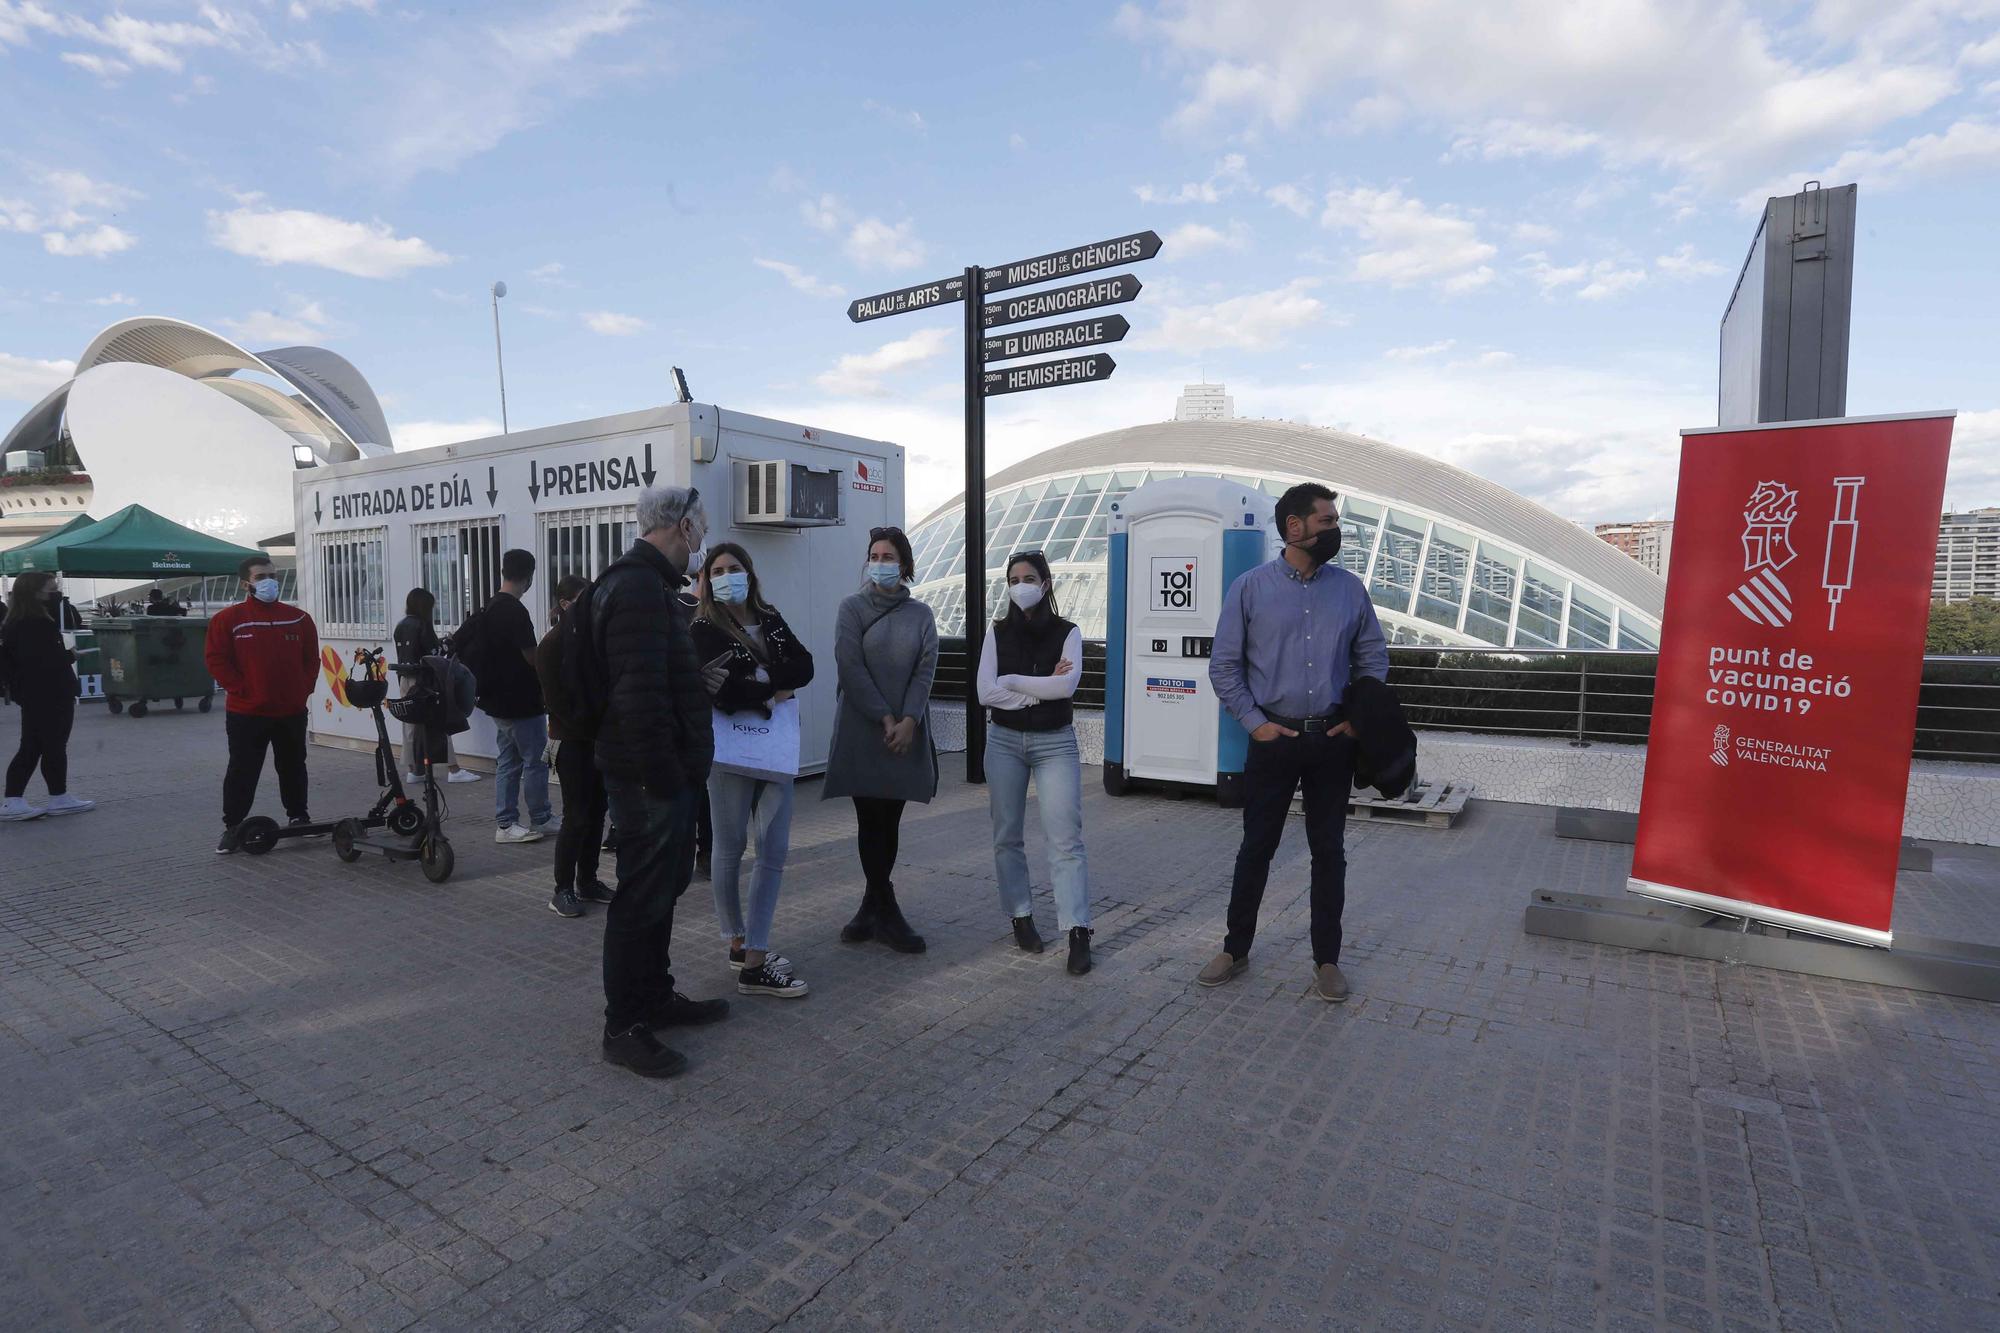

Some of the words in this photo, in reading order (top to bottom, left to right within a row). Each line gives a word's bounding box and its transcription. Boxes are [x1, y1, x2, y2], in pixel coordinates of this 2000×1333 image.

[1058, 256, 1067, 264] DE
[1072, 238, 1141, 269] CIÈNCIES
[984, 269, 1001, 280] 300m
[1008, 257, 1056, 284] MUSEU
[1058, 264, 1070, 273] LES
[945, 280, 962, 290] 400m
[896, 294, 904, 302] DE
[896, 302, 906, 310] LES
[907, 285, 940, 307] ARTS
[1008, 281, 1122, 319] OCEANOGRÀFIC
[857, 296, 895, 318] PALAU
[984, 305, 1002, 314] 750m
[984, 340, 1002, 350] 150m
[1022, 323, 1103, 352] UMBRACLE
[984, 373, 1002, 383] 200m
[1008, 359, 1097, 389] HEMISFÈRIC
[543, 456, 640, 497] PRENSA
[332, 488, 407, 520] ENTRADA
[411, 483, 435, 512] DE
[440, 473, 473, 509] DÍA
[152, 561, 192, 569] Heineken
[1160, 571, 1192, 590] TOI
[1160, 589, 1192, 608] TOI
[1709, 646, 1771, 667] punt
[1779, 648, 1813, 671] de
[1709, 668, 1851, 698] vacunació
[733, 722, 770, 735] KIKO
[1736, 736, 1832, 760] GENERALITAT
[1736, 749, 1827, 772] VALENCIANA
